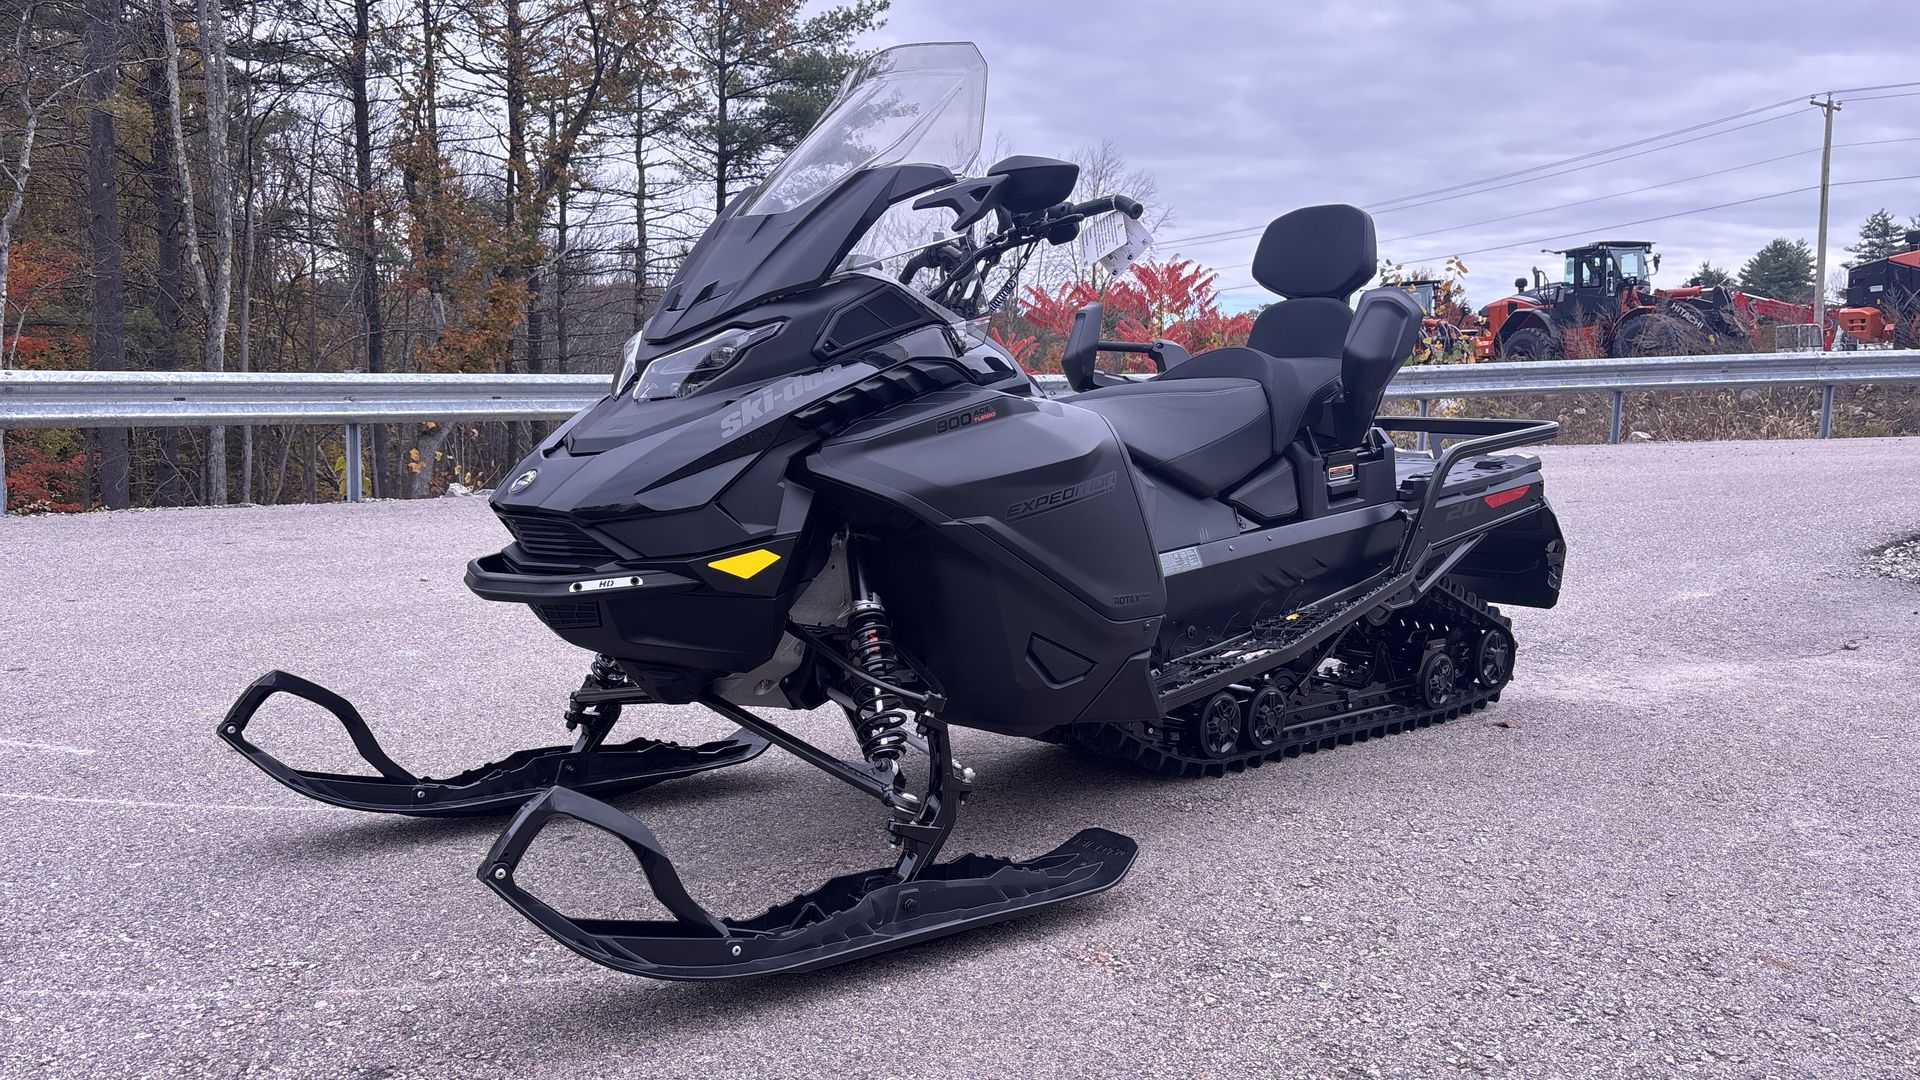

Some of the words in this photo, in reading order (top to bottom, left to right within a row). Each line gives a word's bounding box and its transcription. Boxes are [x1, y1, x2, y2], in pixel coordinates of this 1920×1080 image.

[1670, 302, 1704, 329] HITACHI
[936, 412, 971, 434] 900
[974, 406, 990, 416] ACE
[973, 412, 996, 423] TURBO
[1006, 473, 1116, 518] EXPEDITION
[599, 580, 614, 589] HD
[1114, 594, 1140, 606] ROTAX
